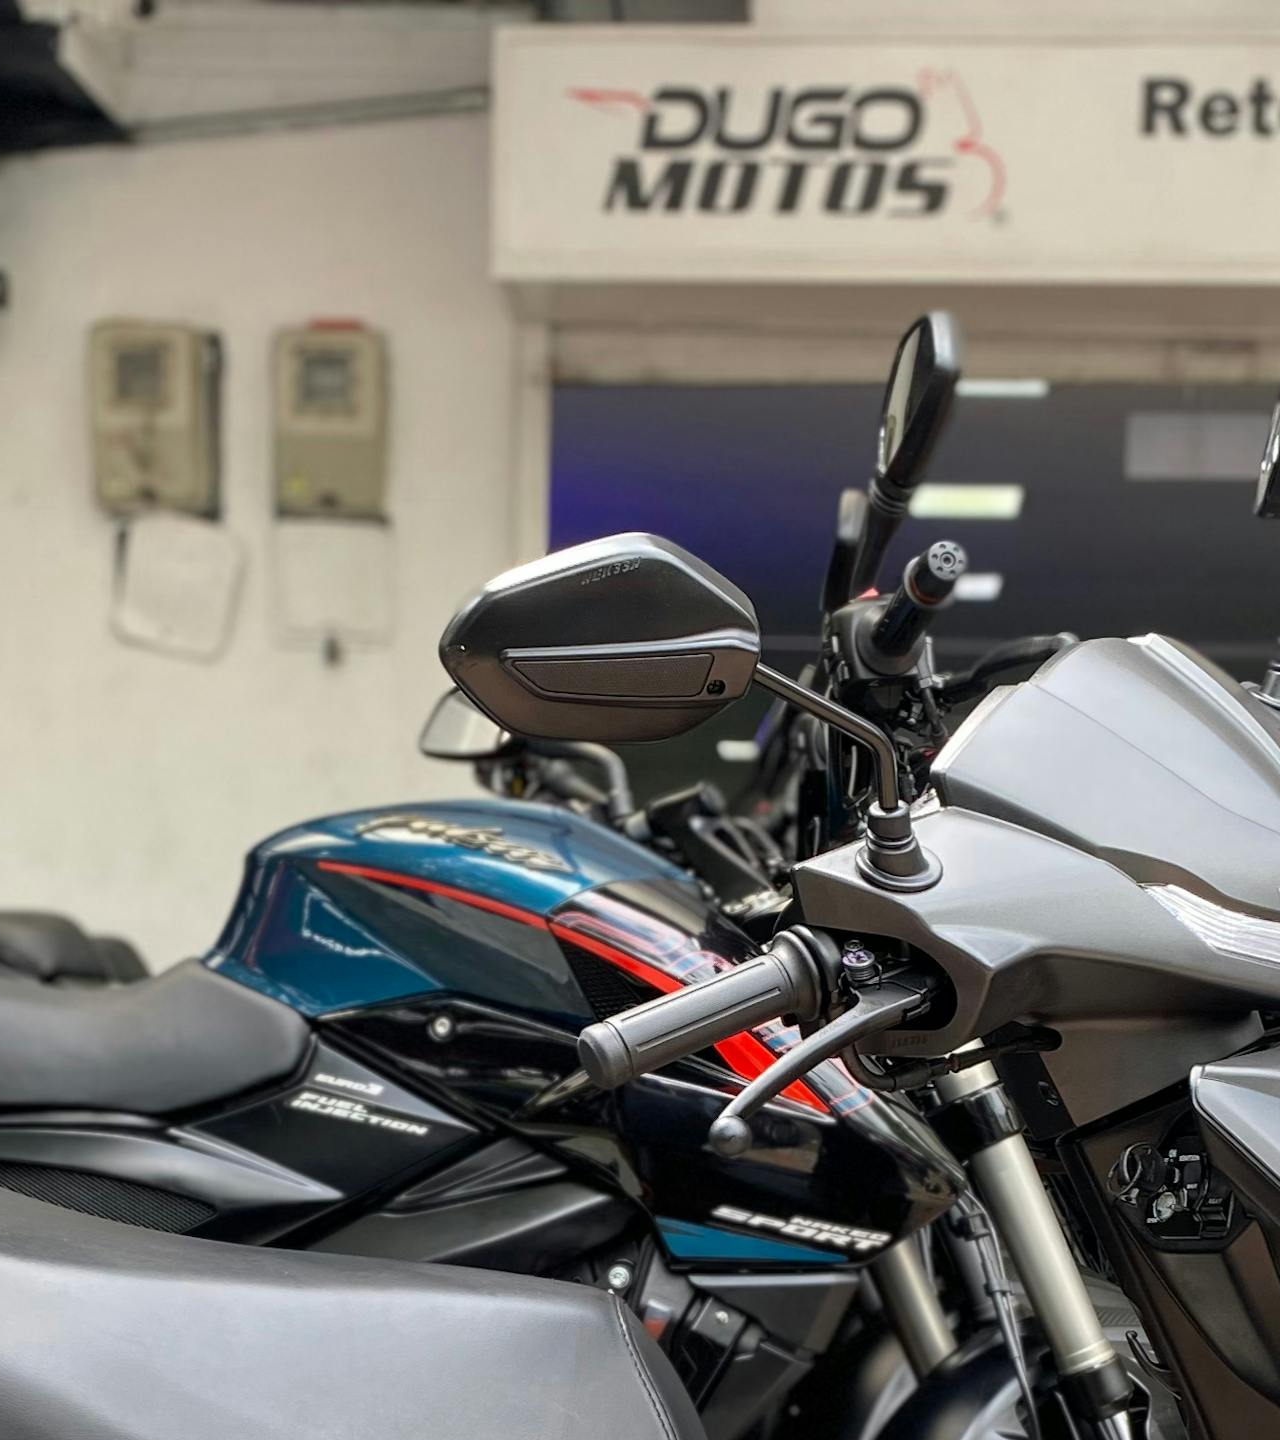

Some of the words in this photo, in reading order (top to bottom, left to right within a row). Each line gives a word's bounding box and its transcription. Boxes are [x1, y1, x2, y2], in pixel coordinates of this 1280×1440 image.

[641, 85, 925, 152] DUGO
[603, 156, 956, 214] MOTOS
[290, 1097, 429, 1137] INJECTION
[299, 1090, 369, 1114] FUEL
[712, 1205, 885, 1252] SPORT
[789, 1215, 893, 1243] NAKED
